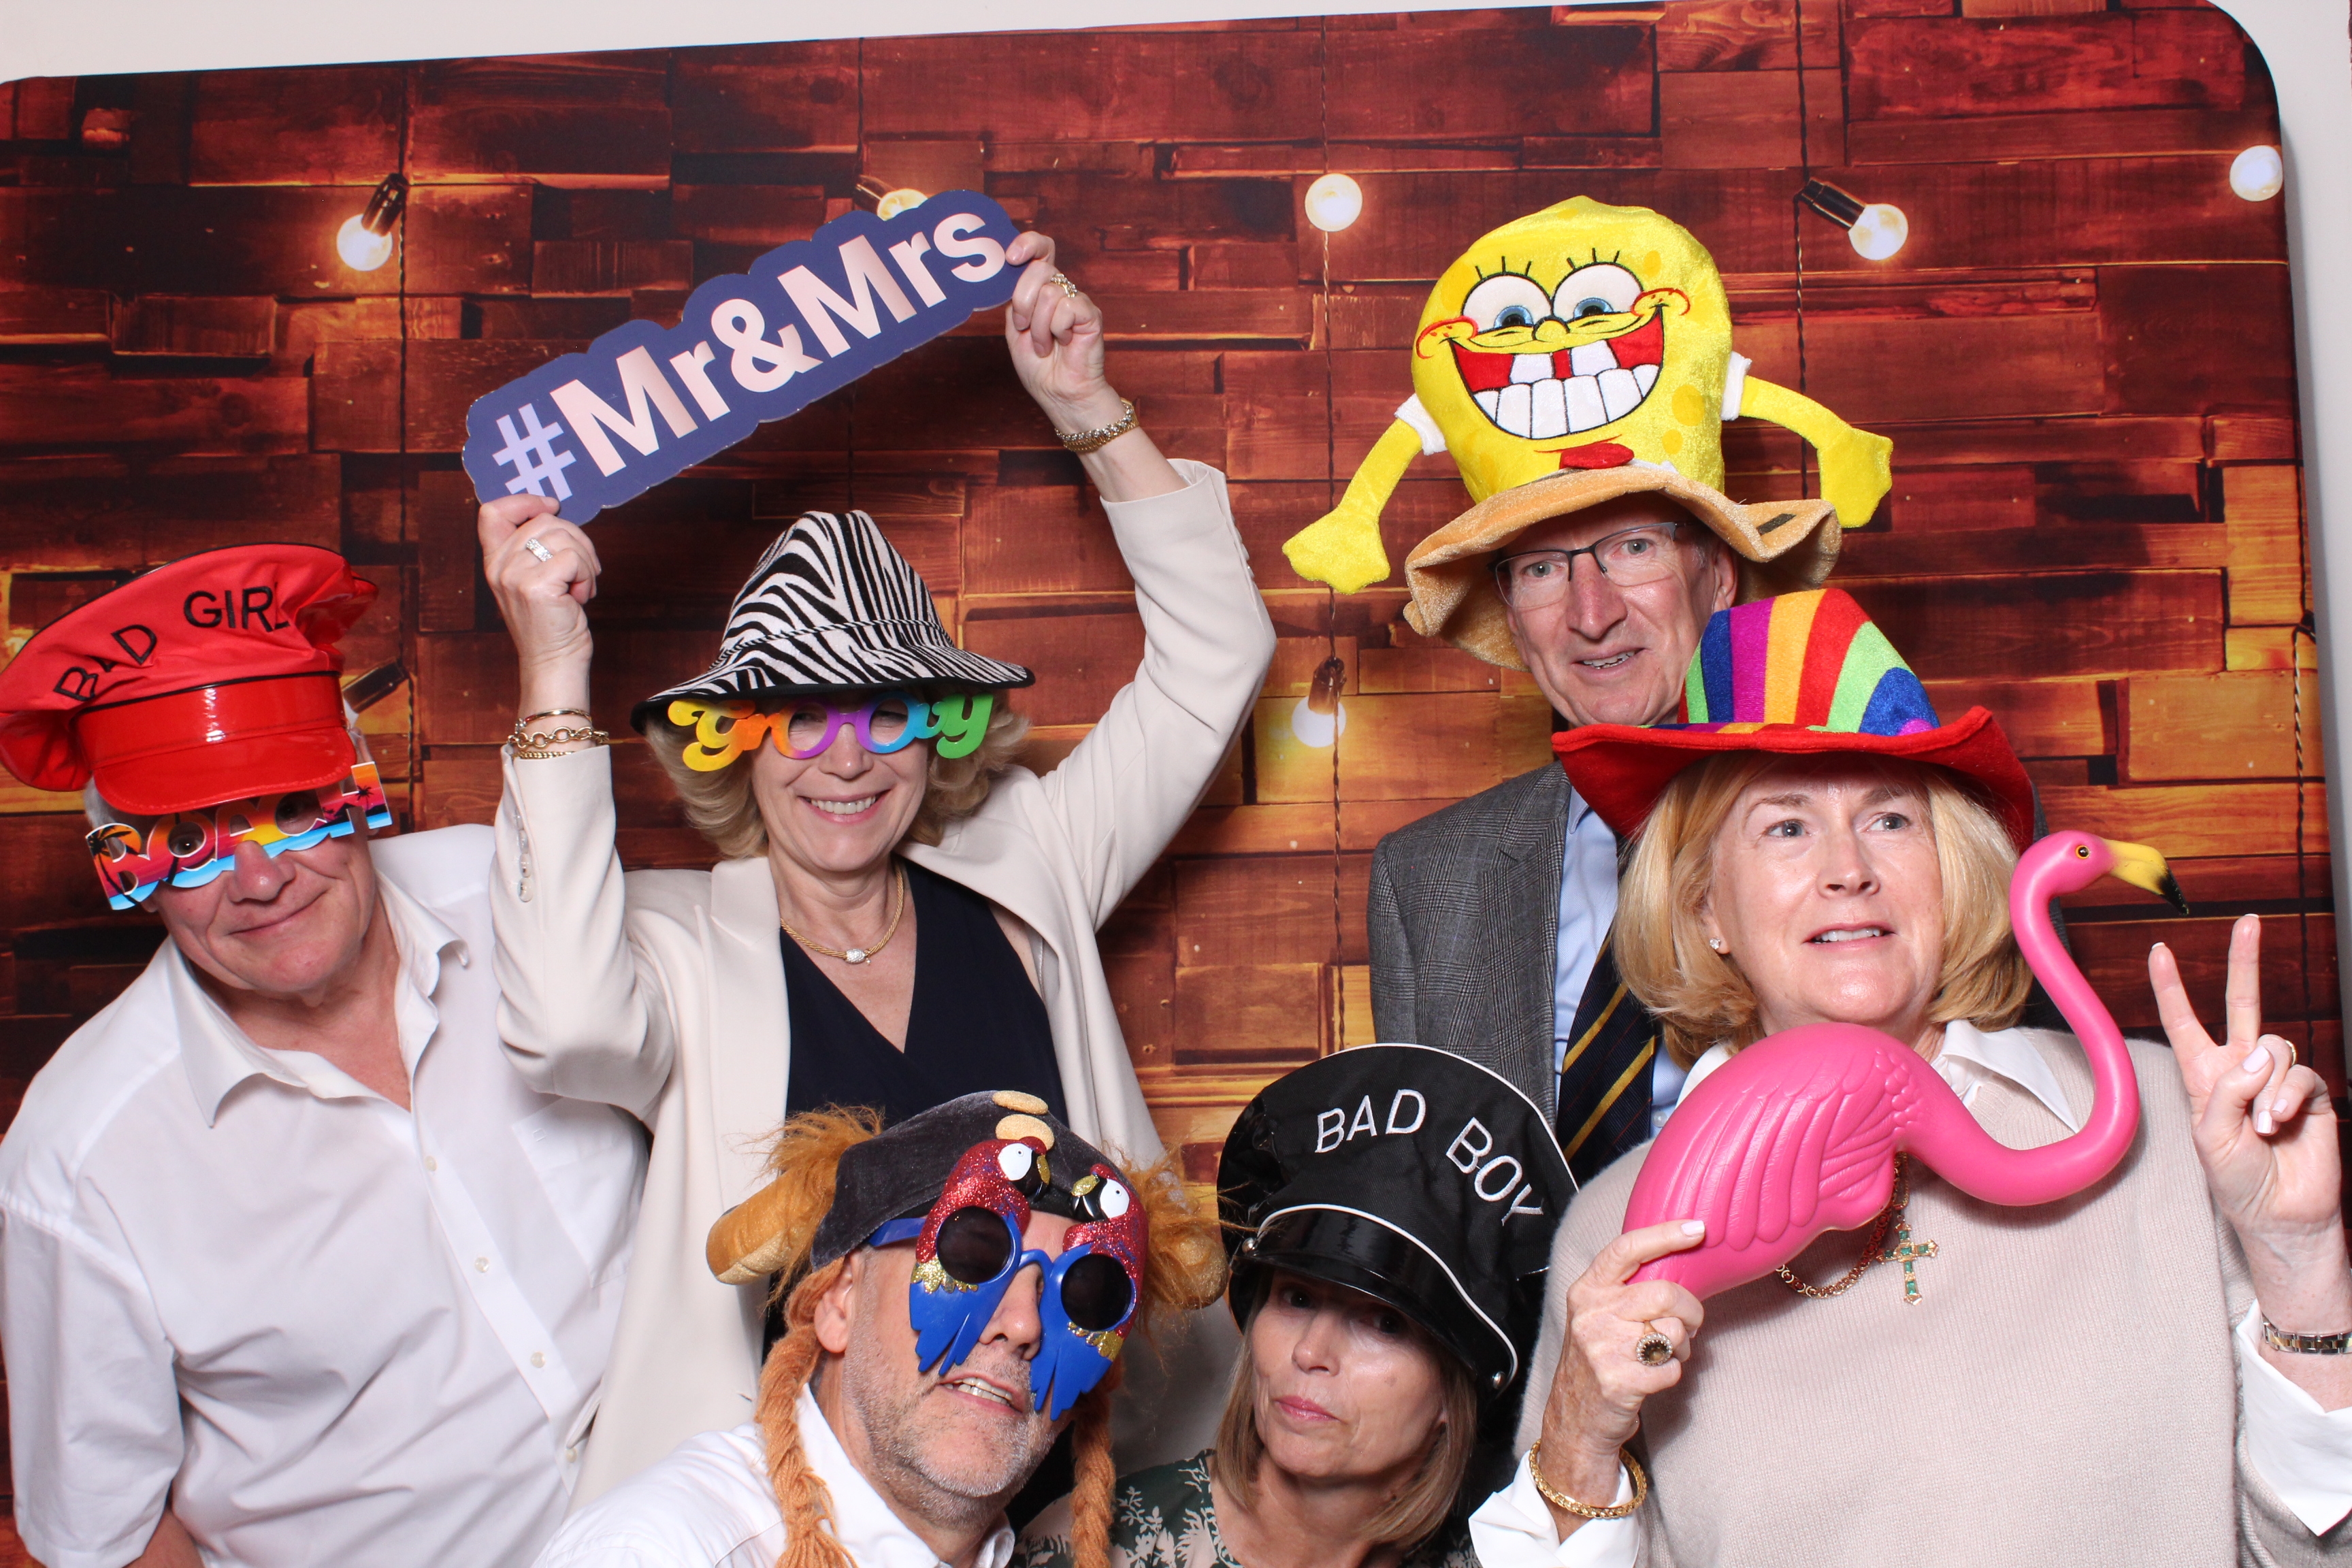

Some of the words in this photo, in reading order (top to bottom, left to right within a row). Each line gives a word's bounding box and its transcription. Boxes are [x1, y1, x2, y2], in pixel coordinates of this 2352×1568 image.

[493, 212, 1006, 502] #Mr&Mrs
[1314, 1089, 1426, 1154] BAD
[1446, 1117, 1544, 1226] BOY
